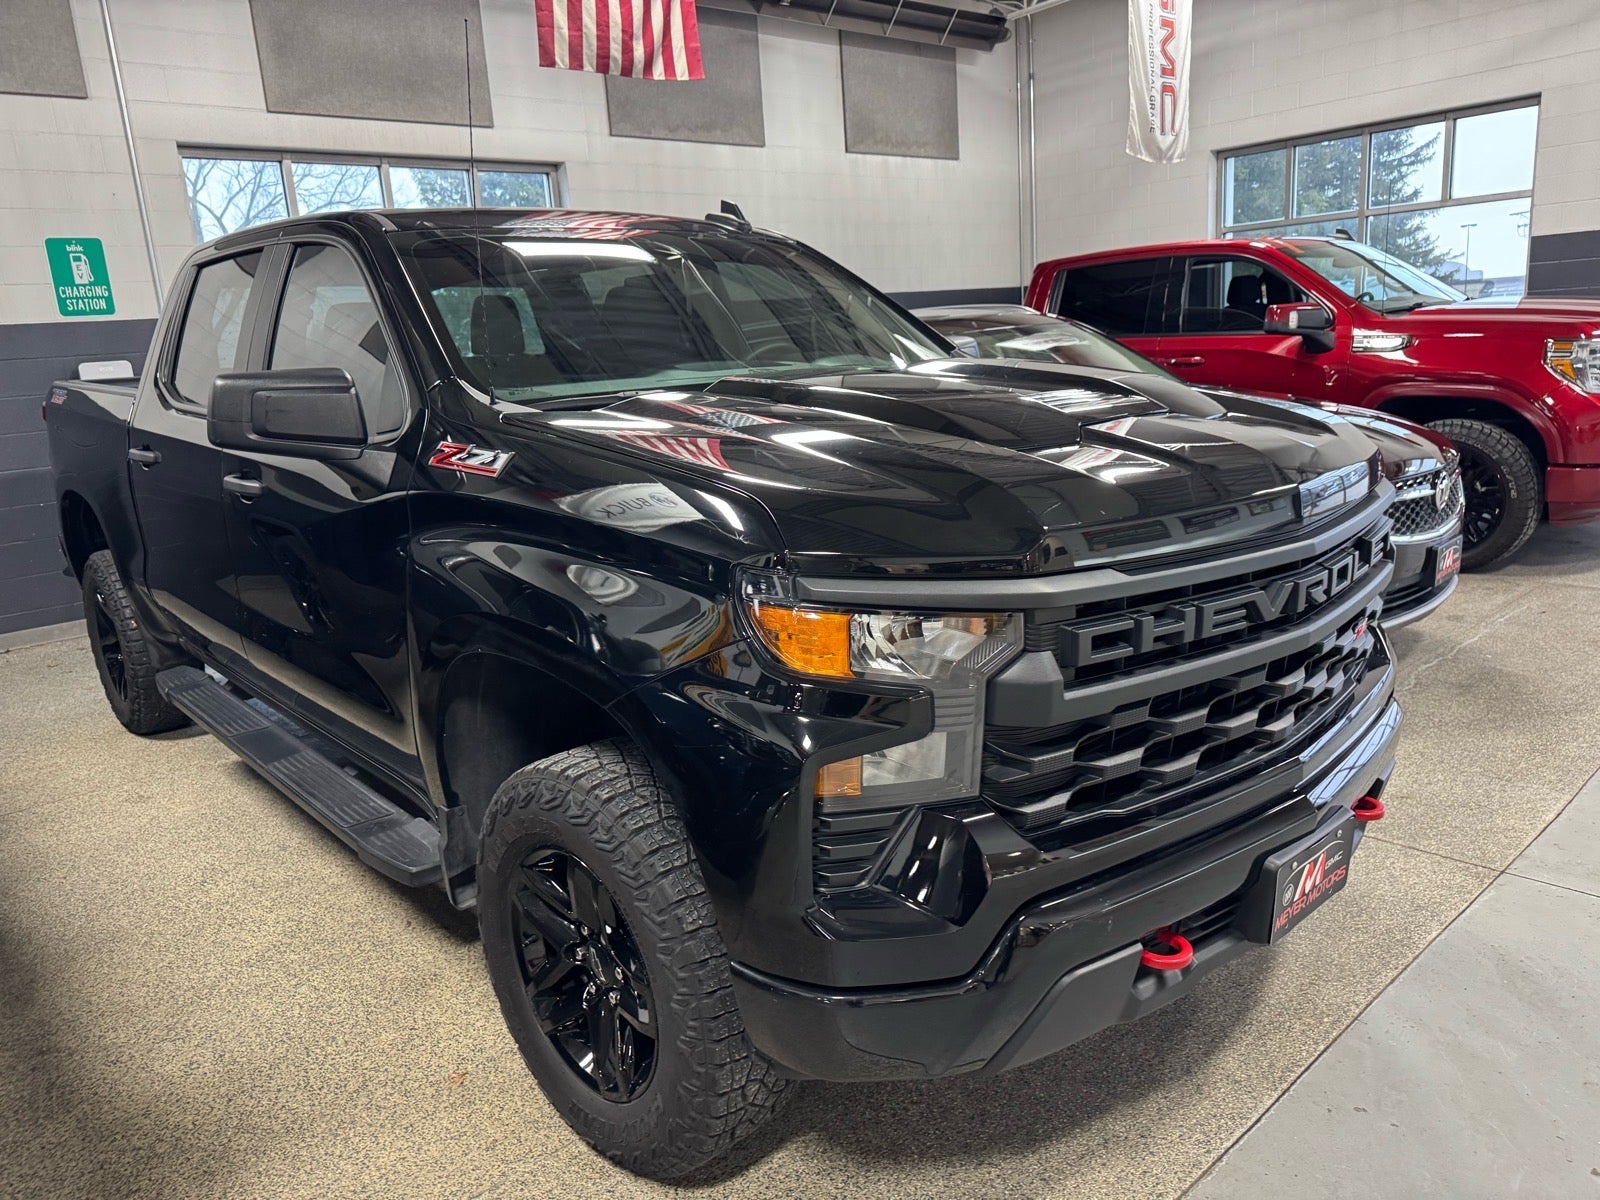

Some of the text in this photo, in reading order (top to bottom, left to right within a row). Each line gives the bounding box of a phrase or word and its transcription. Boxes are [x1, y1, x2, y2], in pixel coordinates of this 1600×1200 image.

[1159, 0, 1177, 136] MC
[65, 240, 84, 252] blink
[59, 285, 109, 298] CHARGING
[66, 298, 107, 312] STATION
[1275, 864, 1347, 932] MEYER MOTORS
